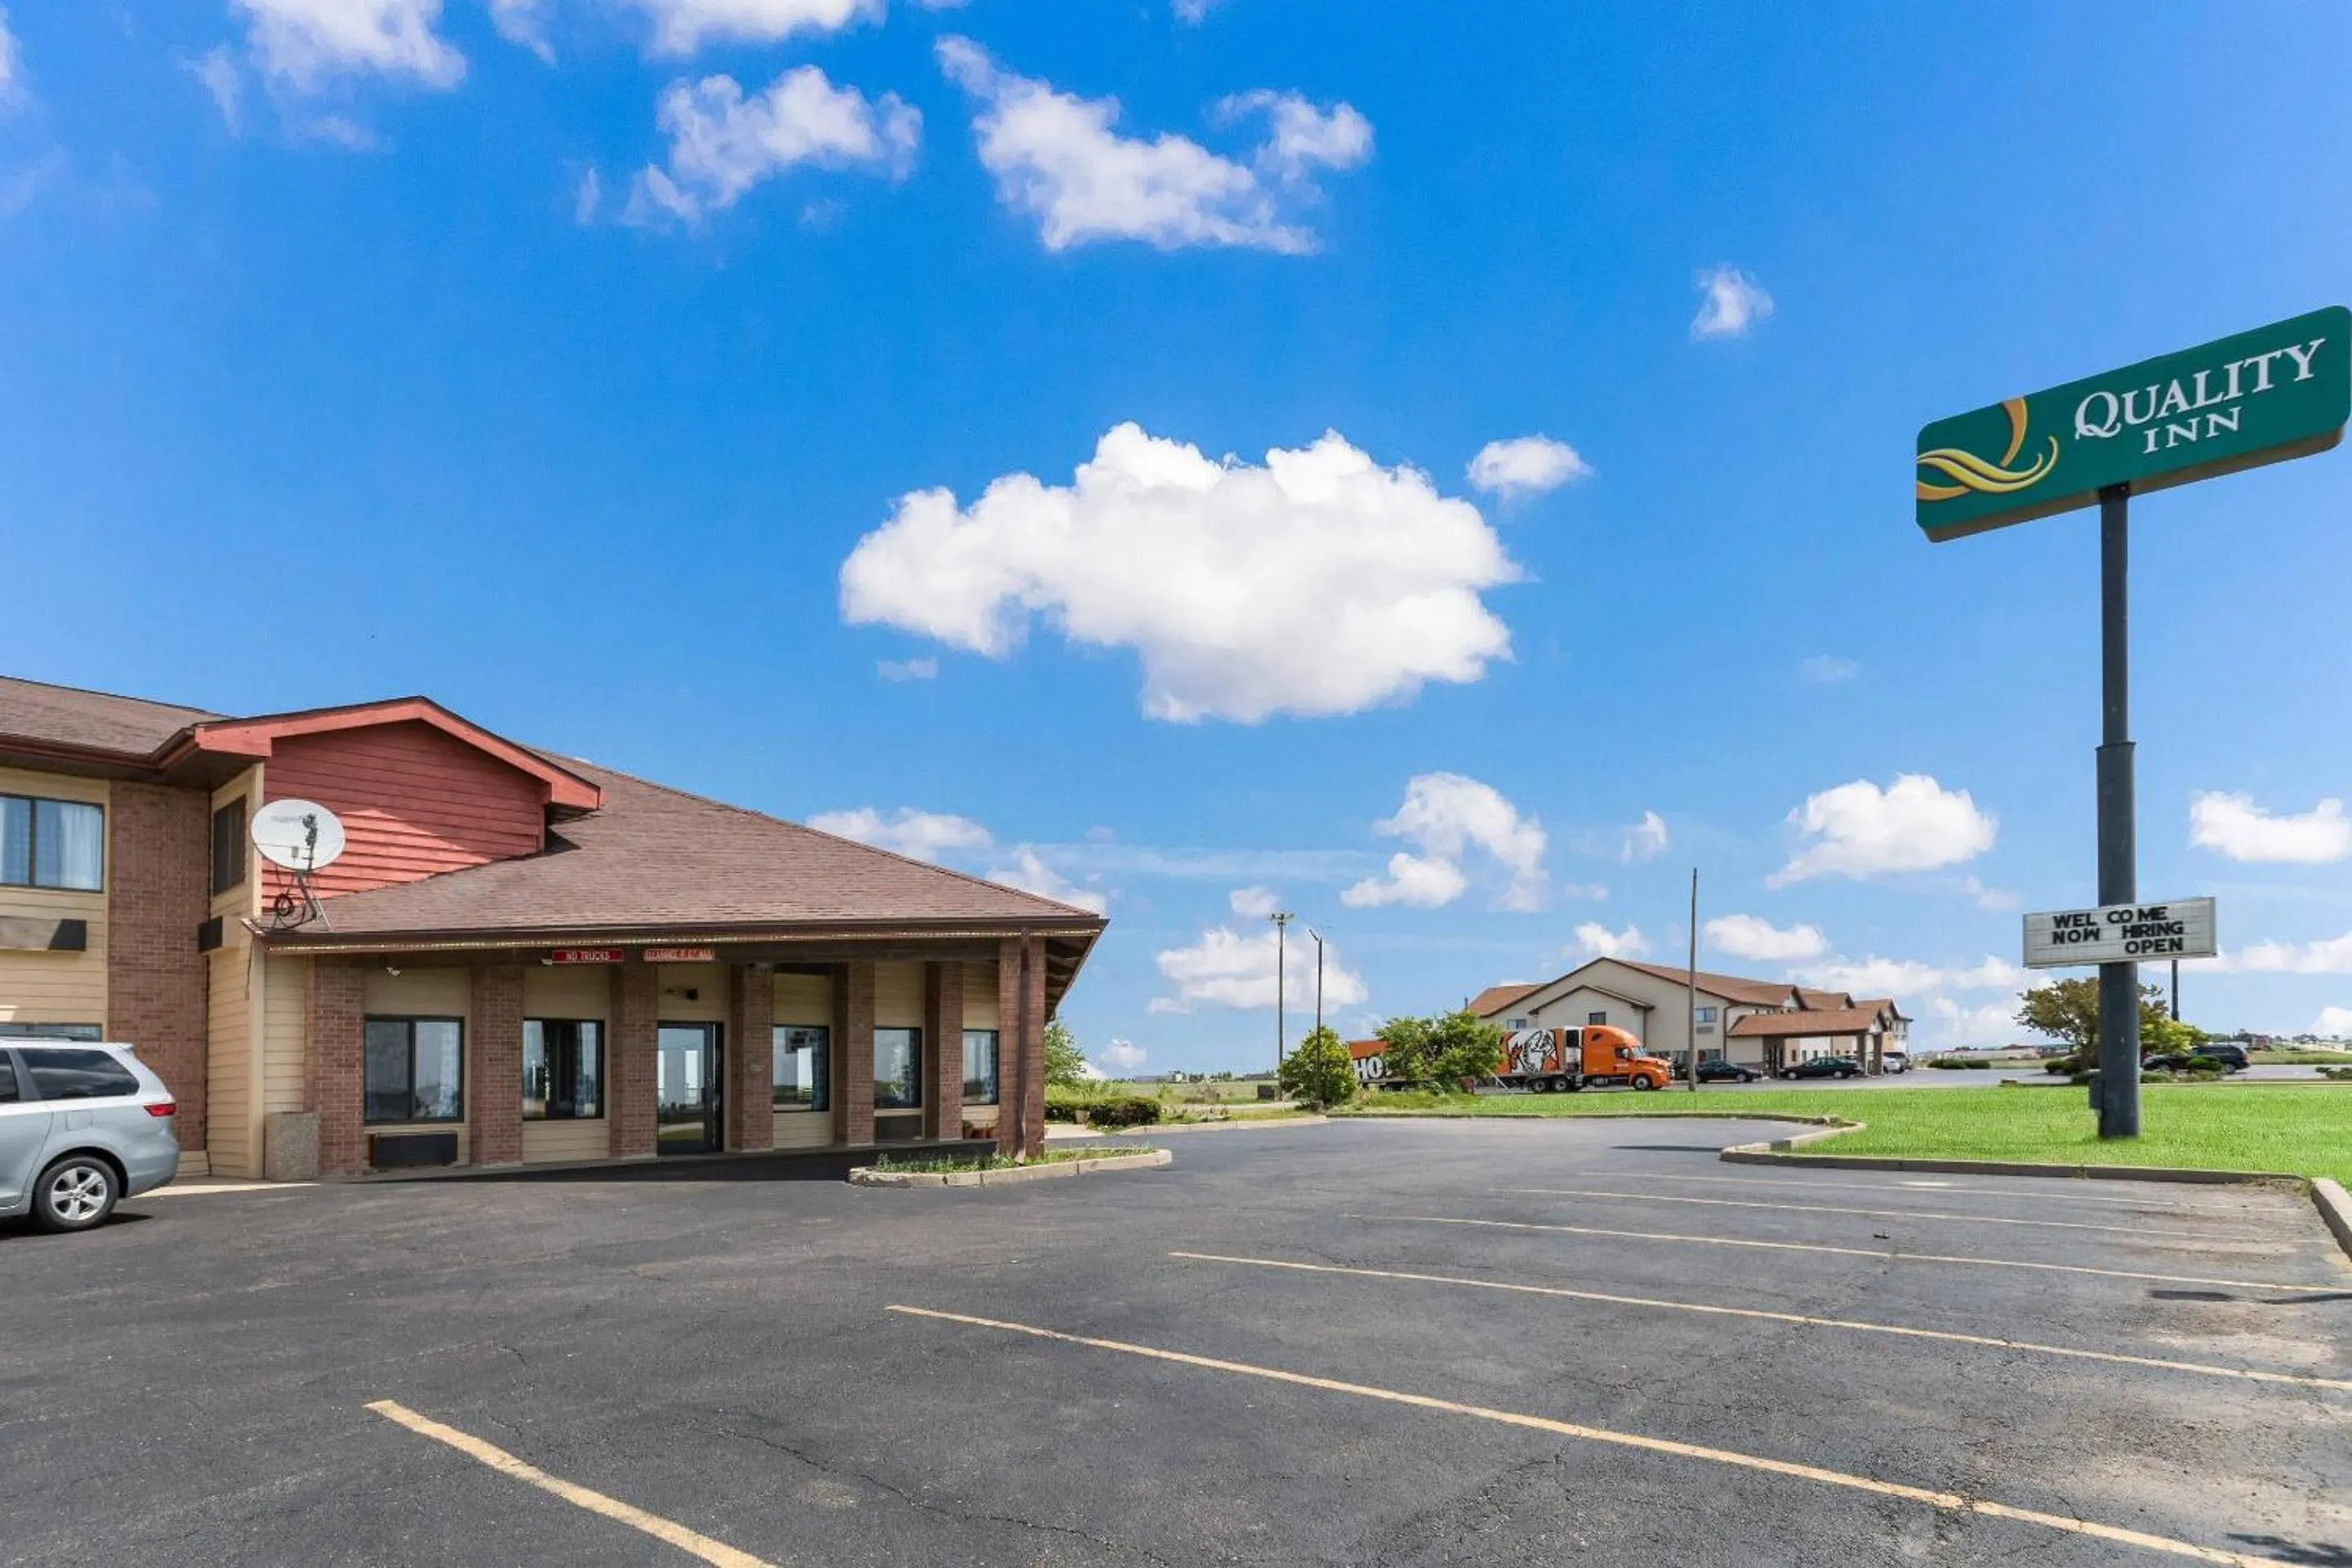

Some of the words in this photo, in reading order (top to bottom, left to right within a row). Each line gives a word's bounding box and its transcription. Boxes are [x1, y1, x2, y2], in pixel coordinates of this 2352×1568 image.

[2074, 337, 2326, 439] QUALITY
[2143, 407, 2241, 454] INN
[2052, 927, 2100, 945] NOW
[2122, 920, 2184, 939] HIRING
[566, 951, 578, 961] NO
[2124, 938, 2184, 954] OPEN
